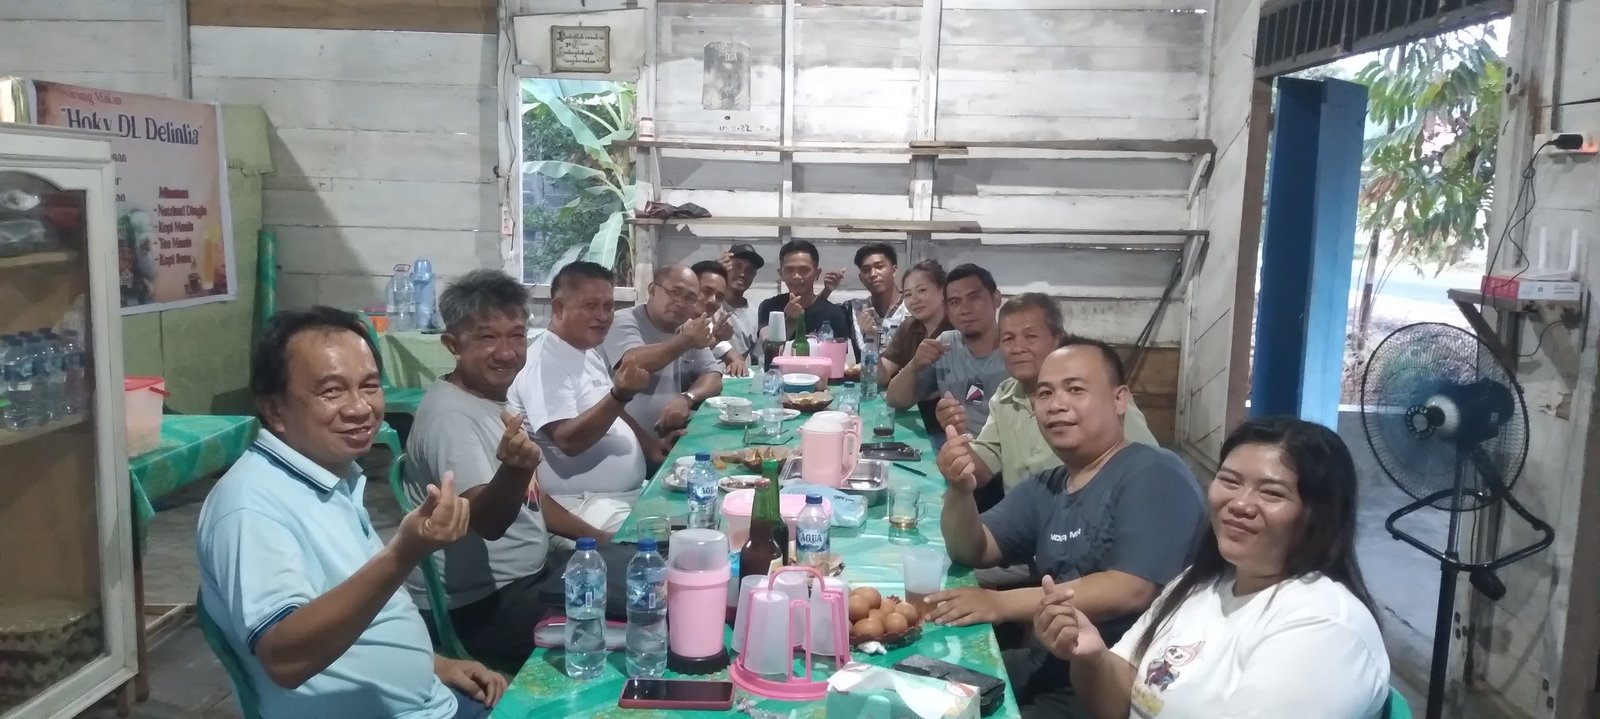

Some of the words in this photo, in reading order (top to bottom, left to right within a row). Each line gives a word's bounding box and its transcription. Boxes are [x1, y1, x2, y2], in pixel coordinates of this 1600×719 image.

[95, 91, 122, 105] Makan
[701, 485, 716, 495] AQU
[800, 533, 823, 545] AQUA
